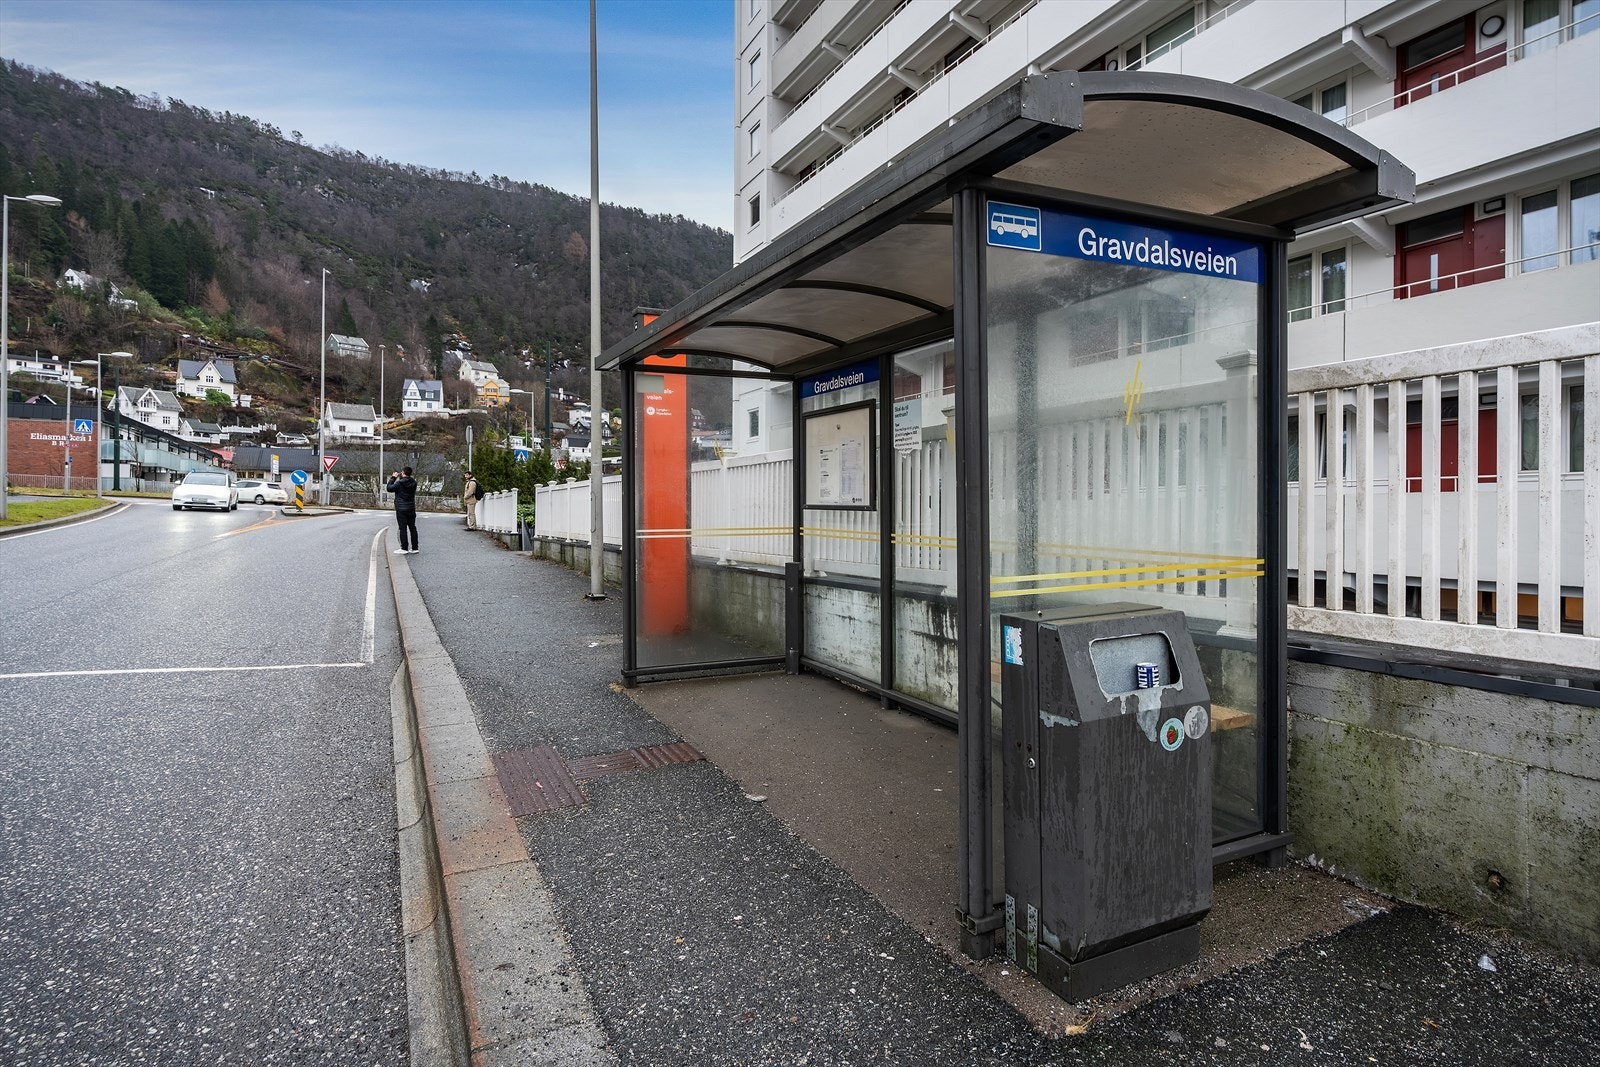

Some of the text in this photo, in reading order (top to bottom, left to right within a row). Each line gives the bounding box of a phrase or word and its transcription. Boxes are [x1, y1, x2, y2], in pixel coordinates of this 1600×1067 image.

[1077, 227, 1238, 276] Gravdalsveien
[814, 371, 864, 393] Gravdalsveien
[30, 433, 86, 441] Eliasmaken
